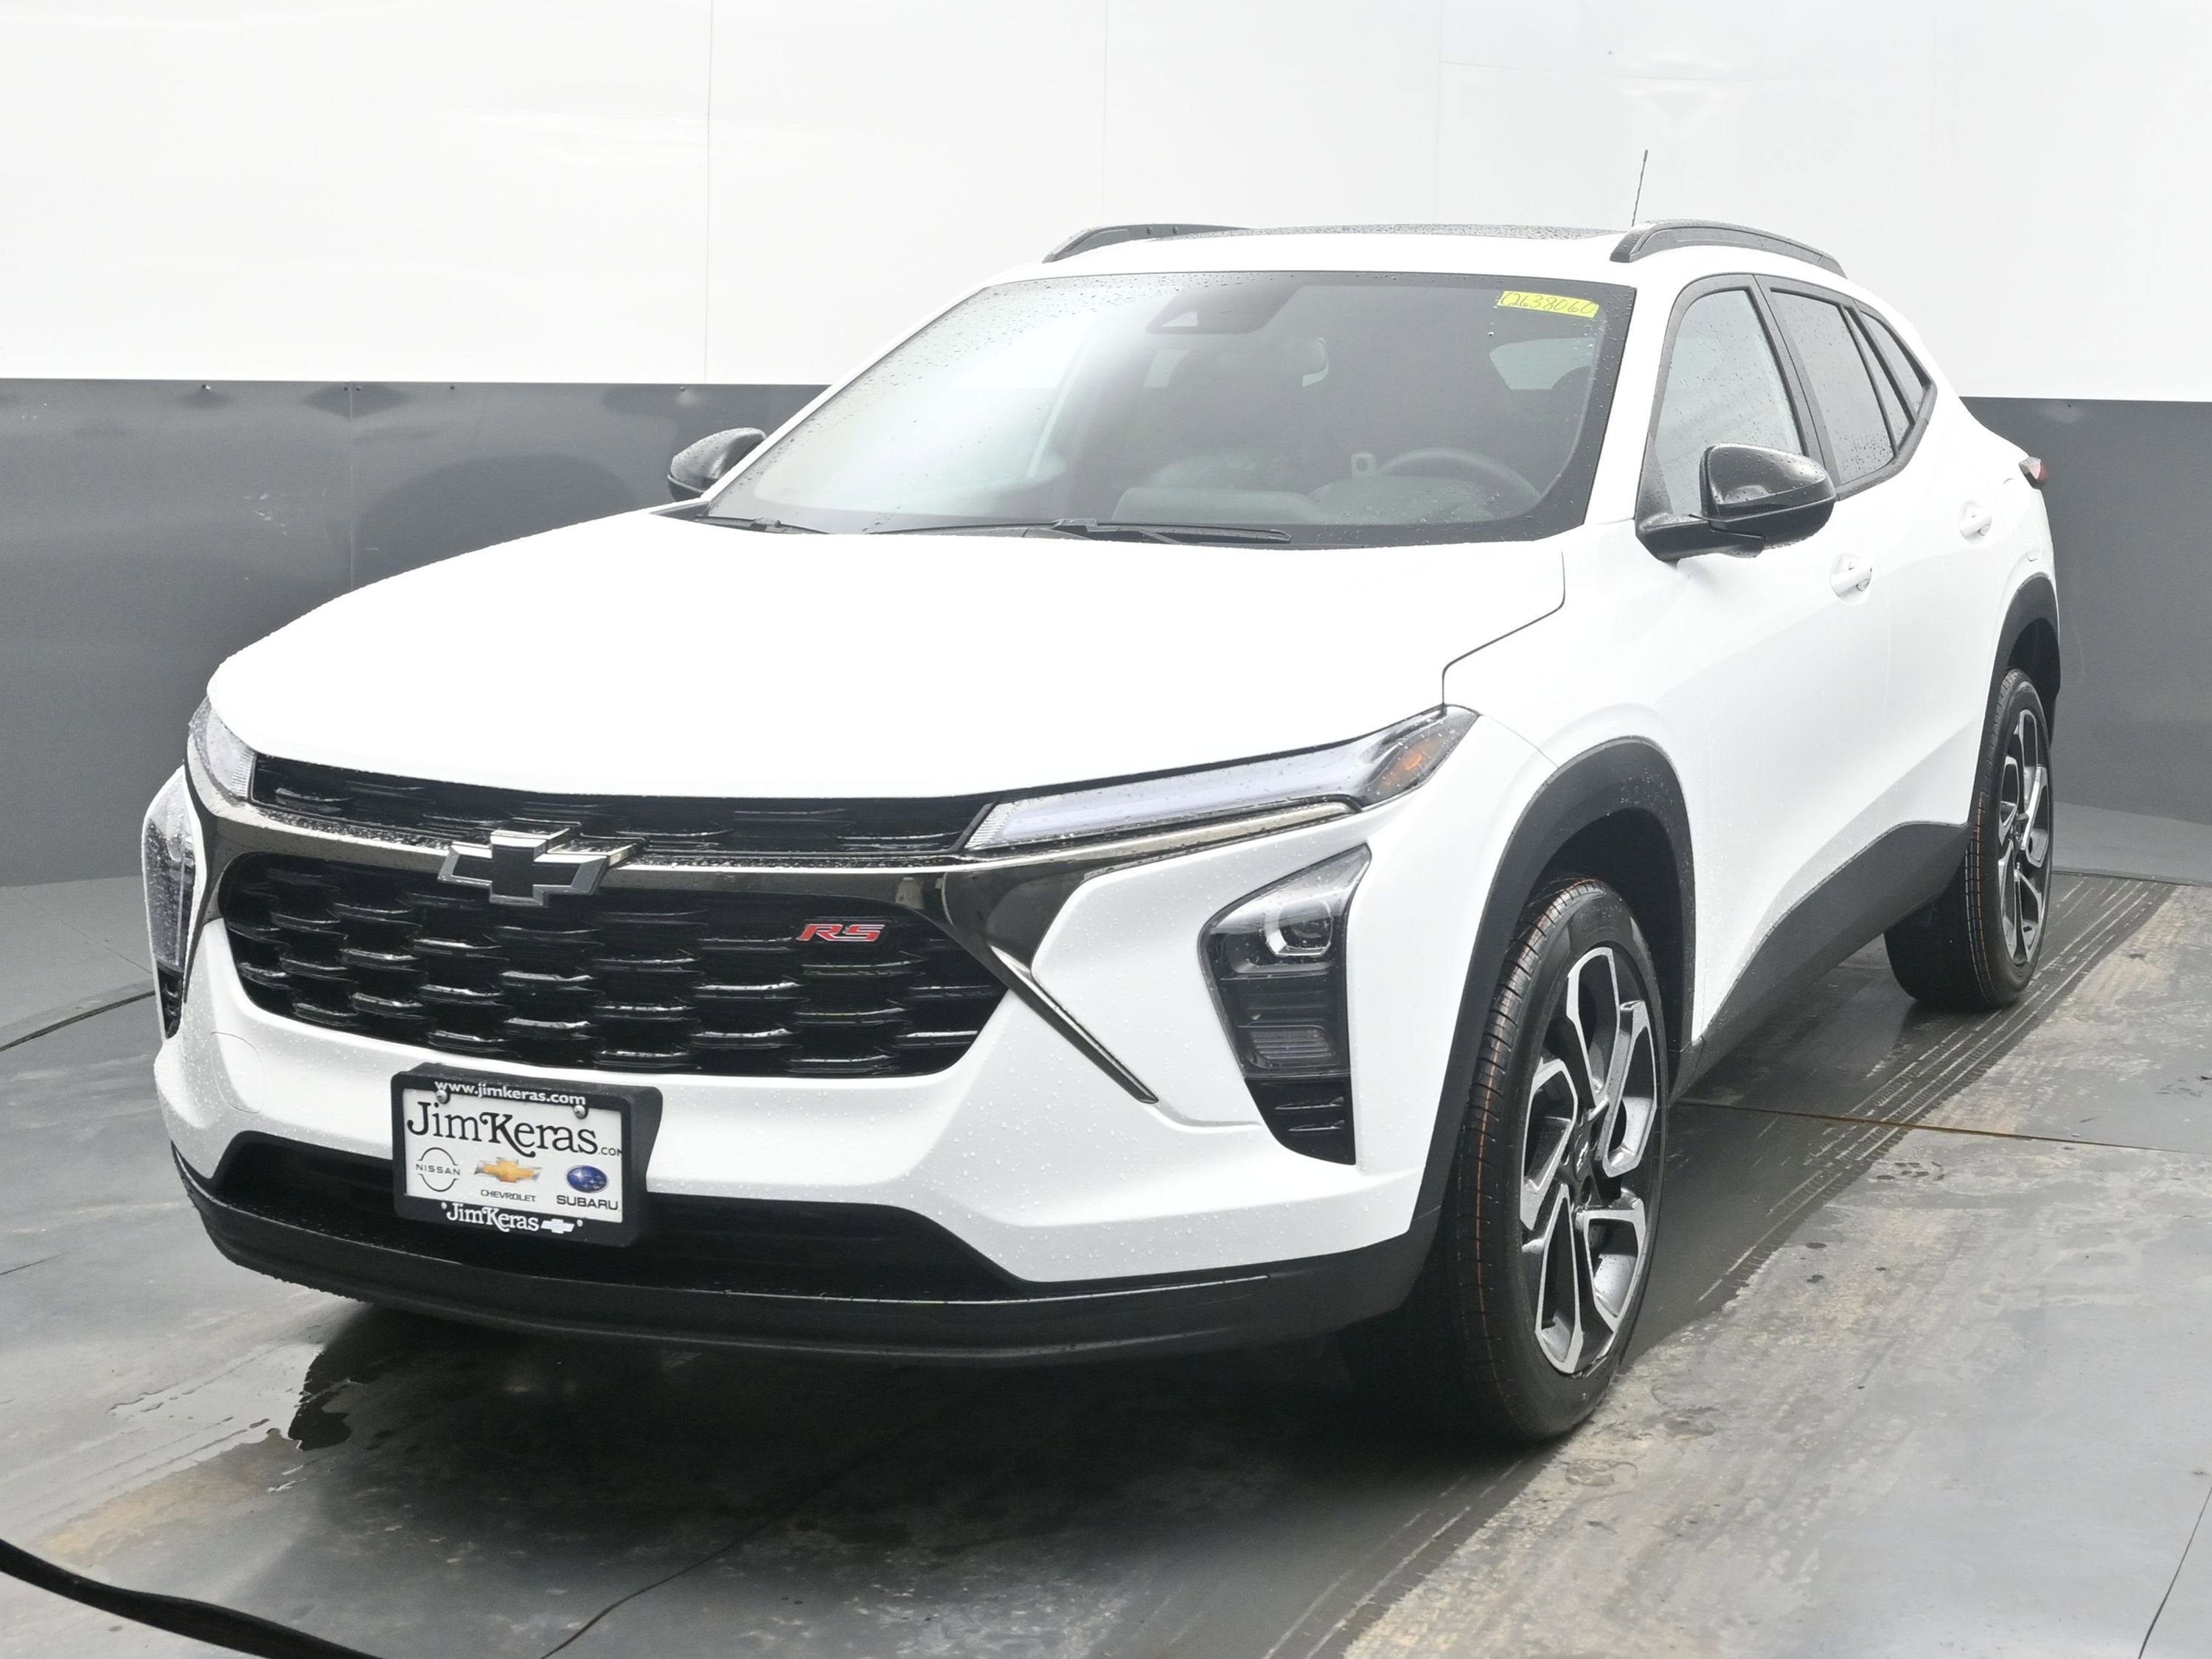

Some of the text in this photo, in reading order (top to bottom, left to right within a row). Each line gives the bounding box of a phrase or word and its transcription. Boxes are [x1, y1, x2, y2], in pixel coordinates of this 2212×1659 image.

[796, 923, 886, 942] RS
[434, 1081, 586, 1105] www.jimkeras.com
[416, 1163, 461, 1176] NISSAN
[480, 1189, 537, 1203] CHEVROLET
[556, 1194, 619, 1211] SUBARU
